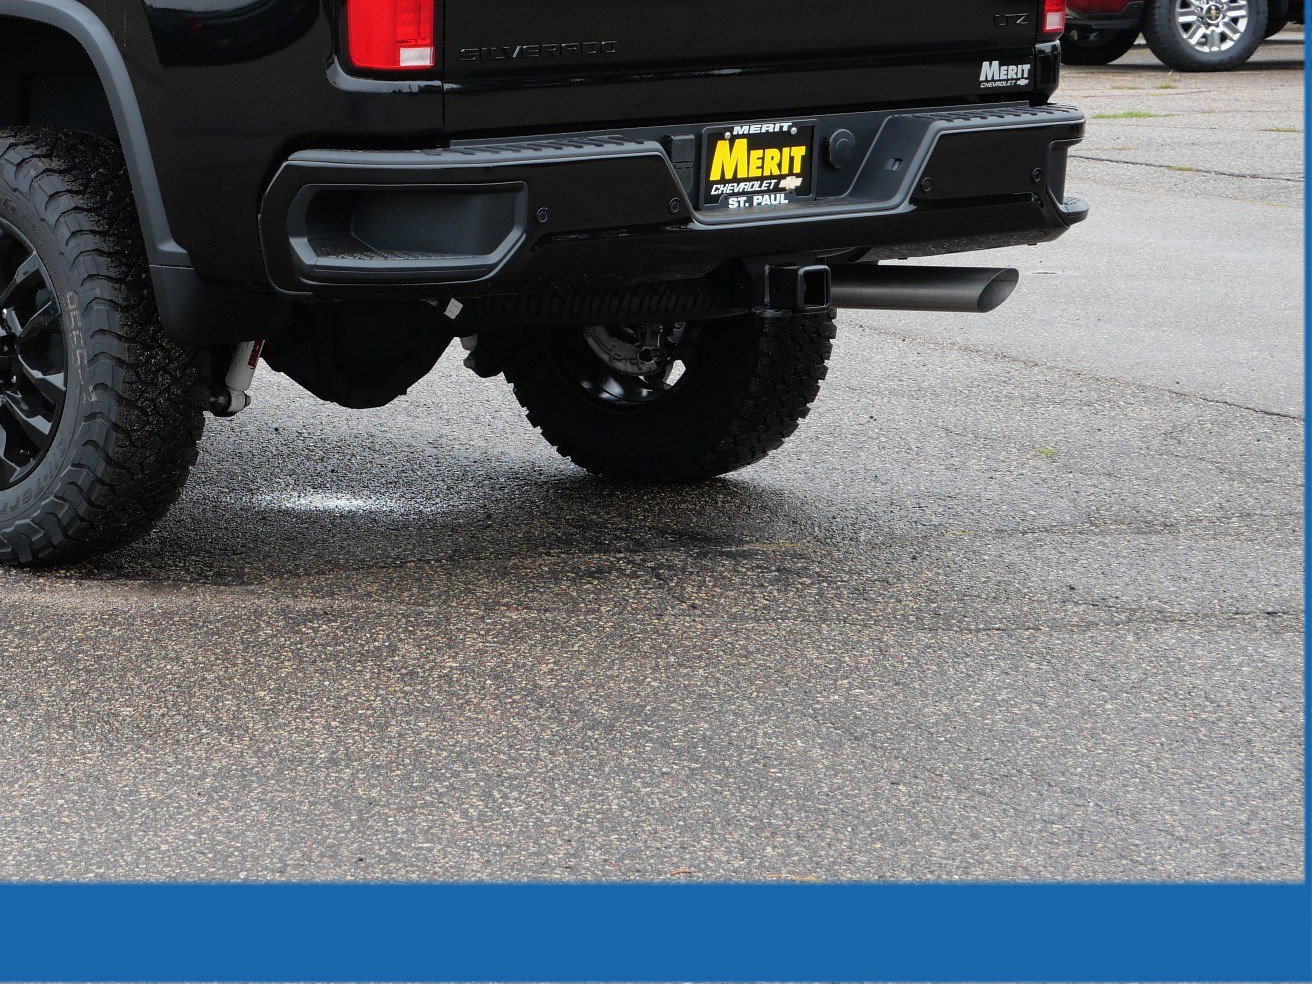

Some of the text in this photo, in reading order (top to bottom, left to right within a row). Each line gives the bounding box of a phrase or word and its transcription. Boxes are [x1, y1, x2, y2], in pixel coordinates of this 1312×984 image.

[459, 40, 619, 62] SILVERADO
[979, 60, 1031, 82] MERIT
[980, 80, 1016, 89] CHEVROLET
[732, 122, 793, 135] MERIT
[709, 137, 807, 182] MERIT
[710, 179, 778, 195] CHEVROLET
[728, 193, 789, 209] ST. PAUL
